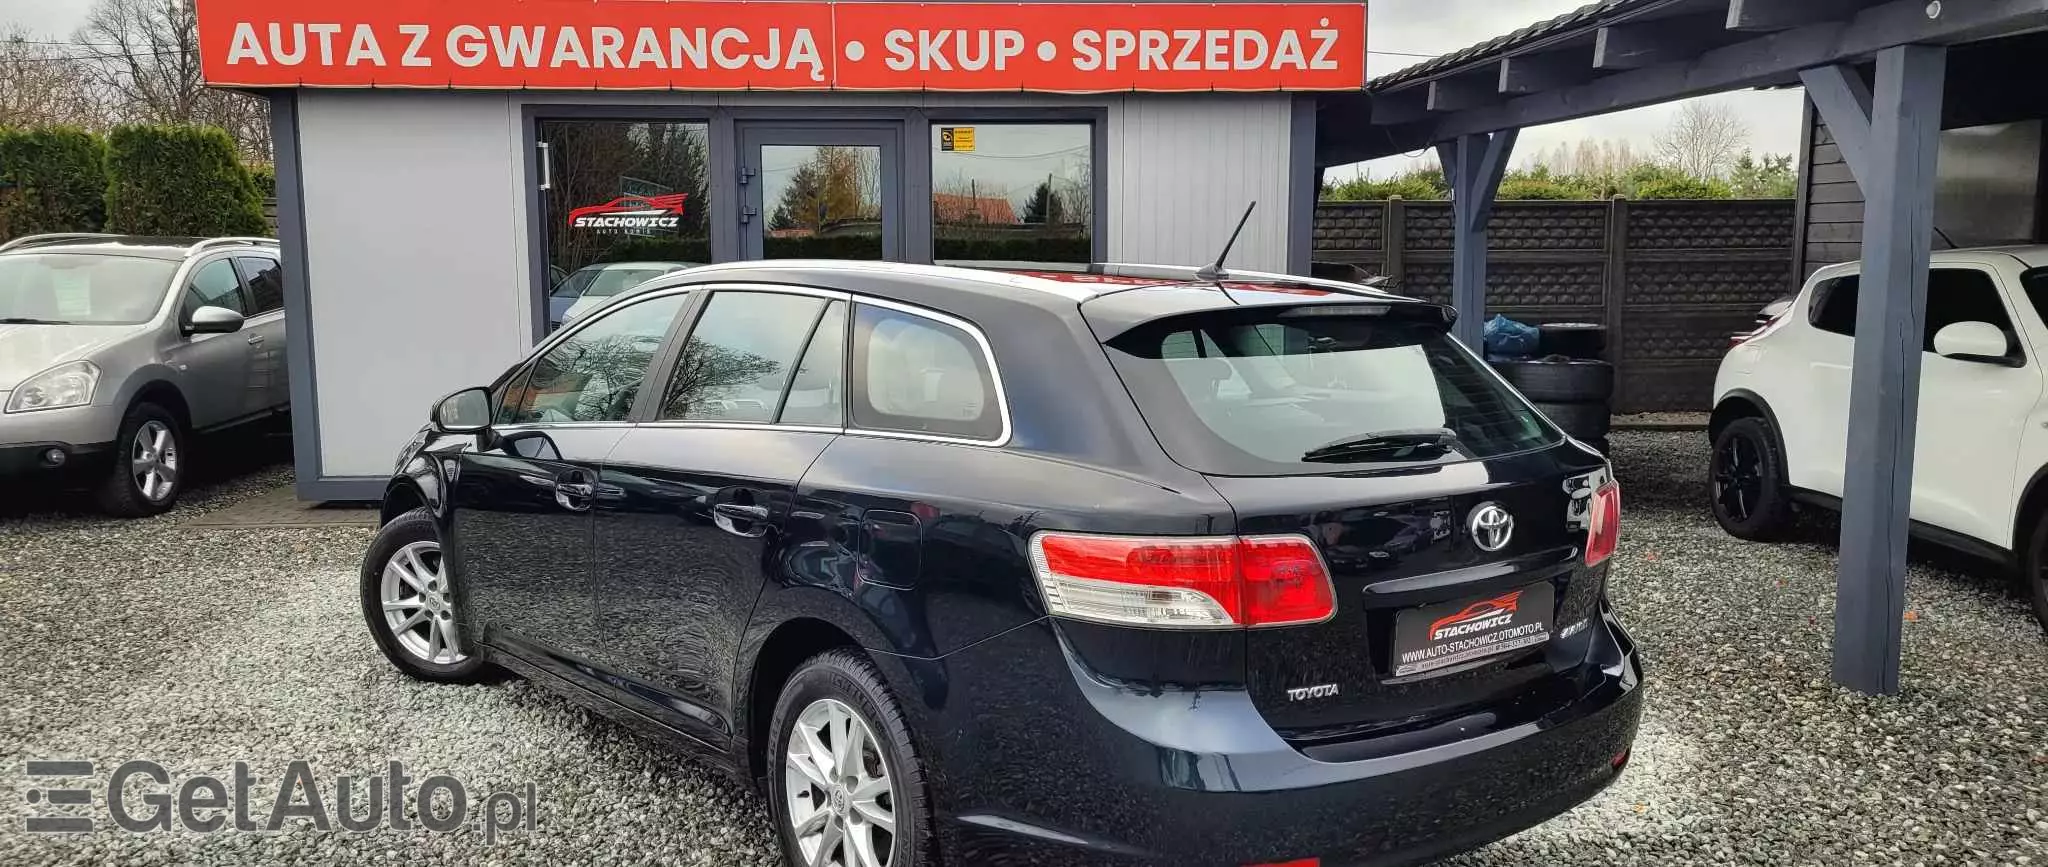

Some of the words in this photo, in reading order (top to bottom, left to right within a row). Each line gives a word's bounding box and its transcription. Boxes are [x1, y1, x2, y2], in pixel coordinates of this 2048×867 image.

[227, 22, 386, 67] AUTA
[399, 25, 432, 67] Z
[446, 25, 824, 82] GWARANCJĄ
[885, 29, 1025, 71] SKUP
[1073, 18, 1339, 71] SPRZEDAŻ
[575, 217, 679, 228] STACHOWICZ
[1434, 613, 1513, 640] STACHOWICZ
[1401, 621, 1545, 664] WWW.AUTO-STACHOWICZ.OTOMOTO.PL
[1287, 683, 1339, 702] TOYOTA
